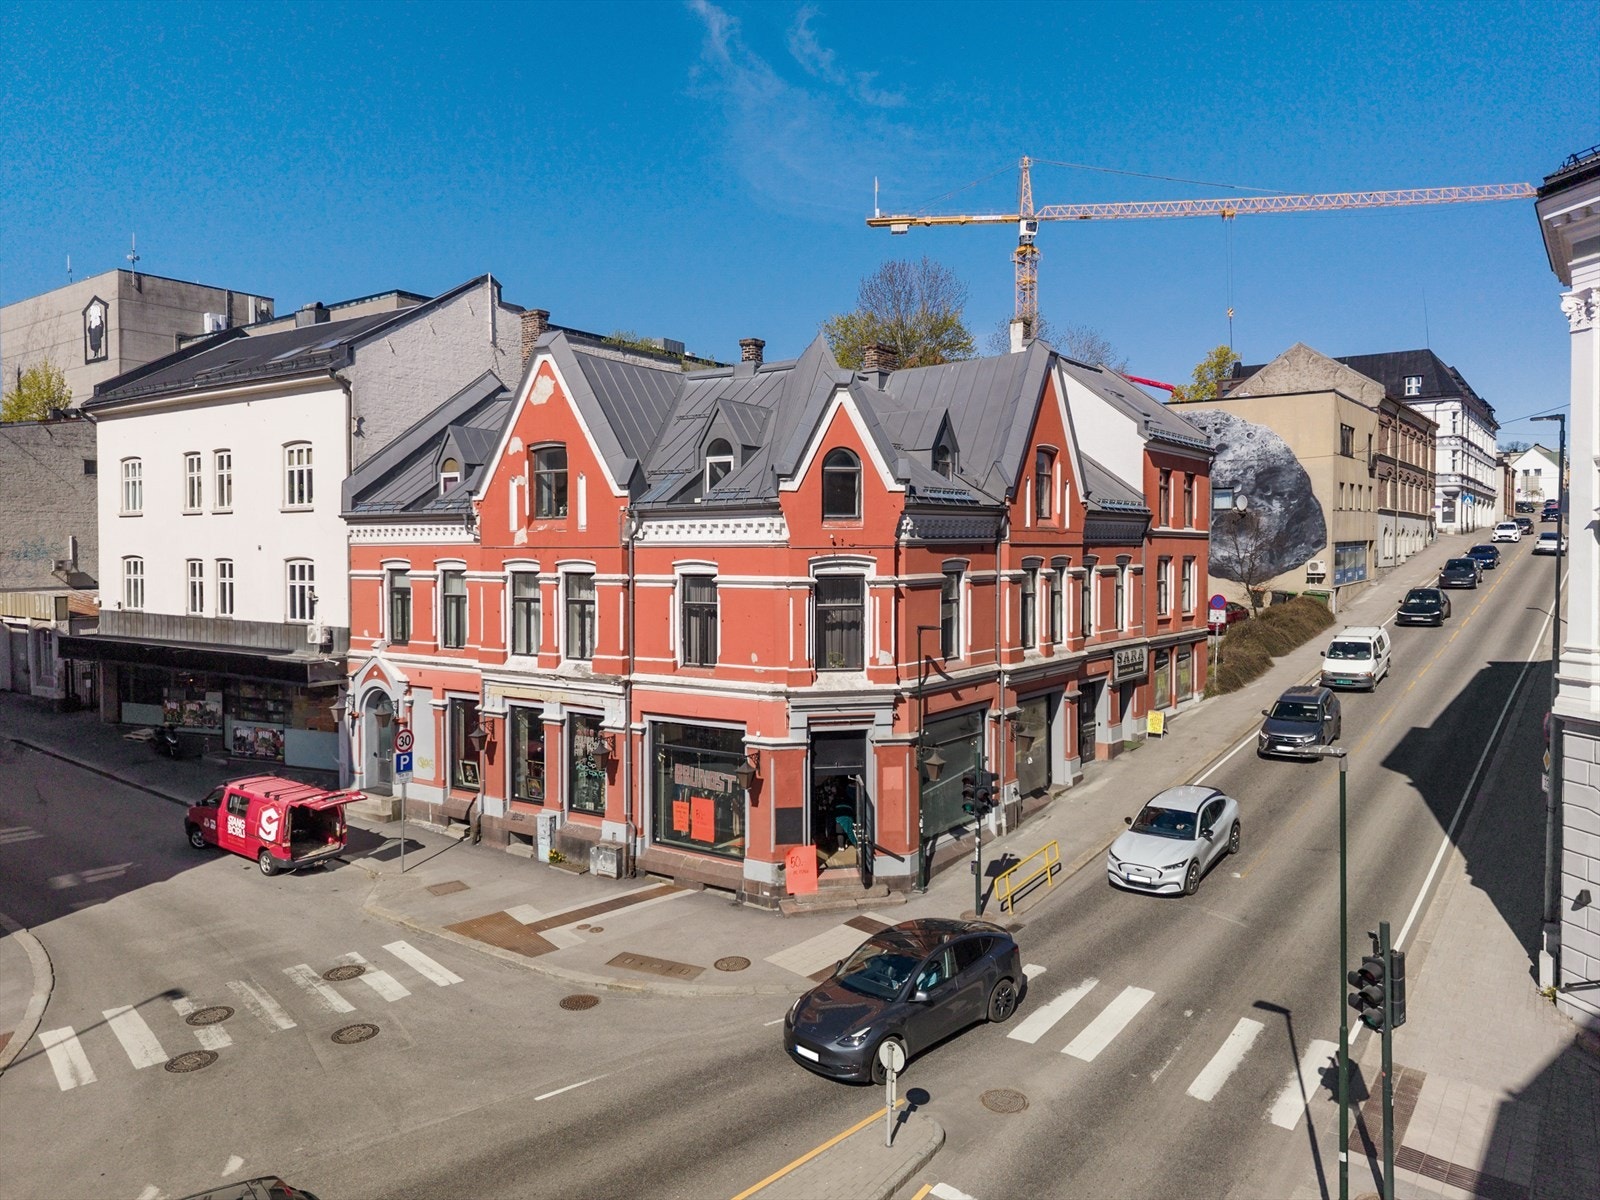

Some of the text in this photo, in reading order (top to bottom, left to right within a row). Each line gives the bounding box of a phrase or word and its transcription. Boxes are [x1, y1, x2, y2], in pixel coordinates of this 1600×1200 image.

[1117, 648, 1144, 666] SARA
[399, 735, 411, 747] 30
[400, 755, 409, 770] P
[674, 763, 737, 794] BRUNOST
